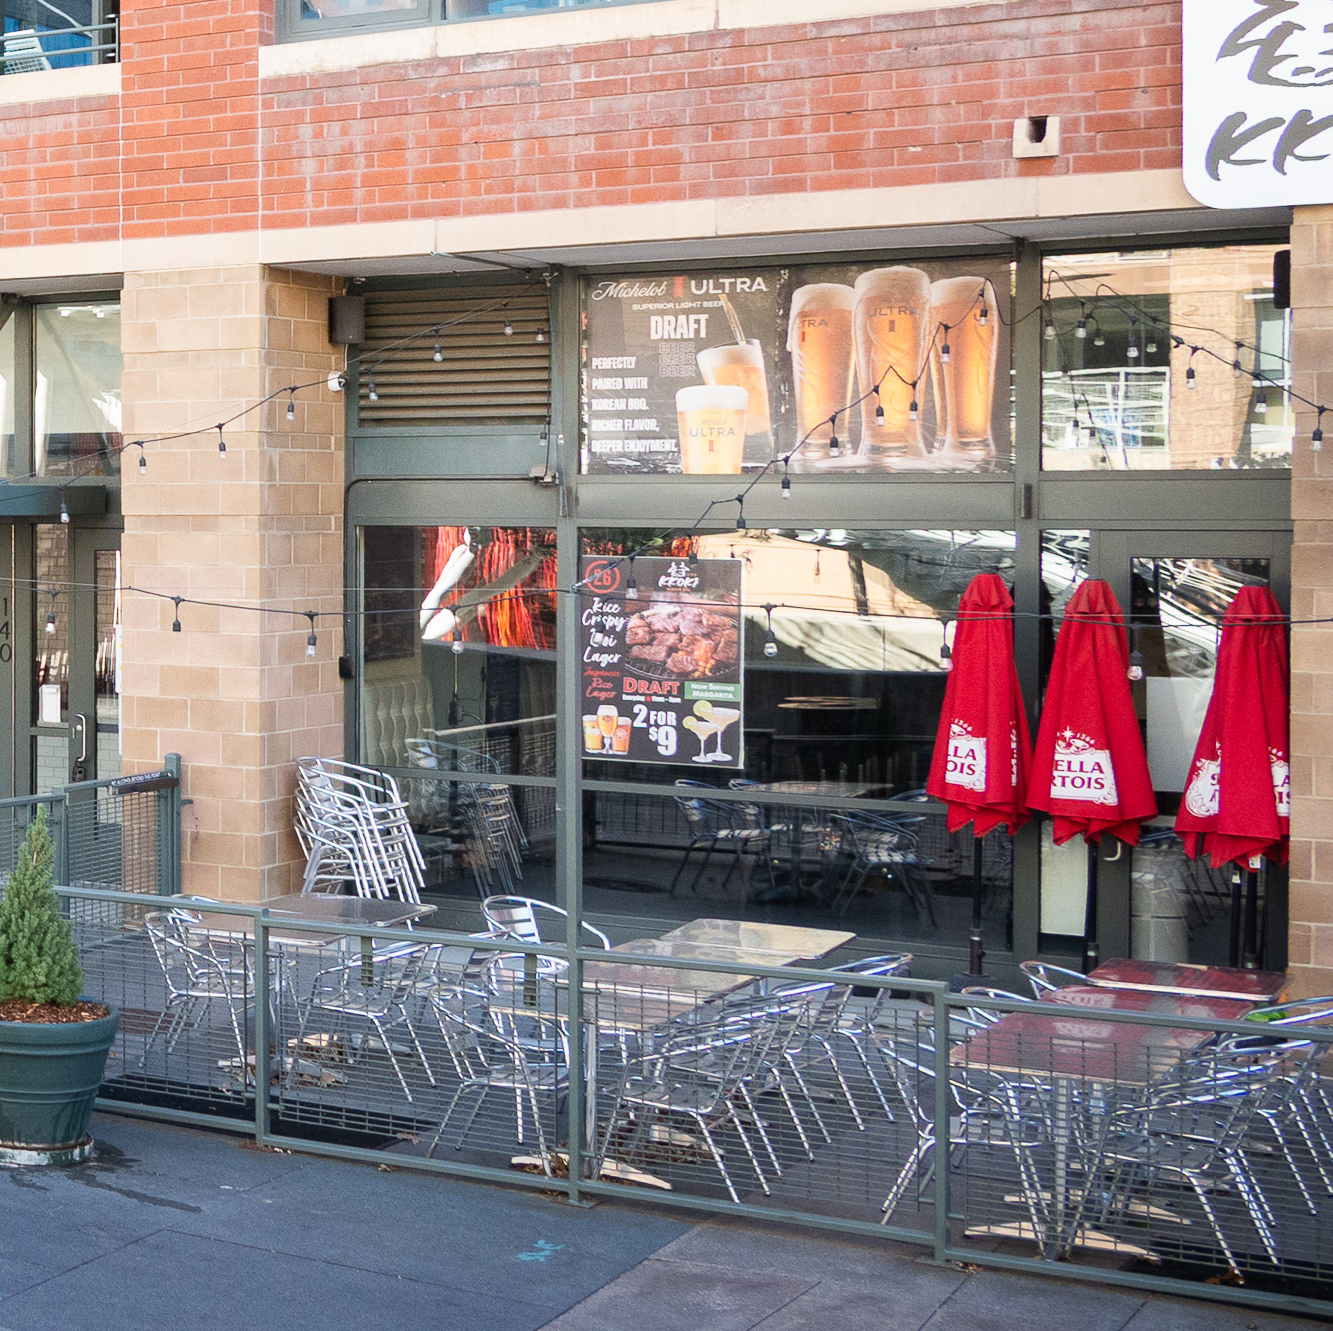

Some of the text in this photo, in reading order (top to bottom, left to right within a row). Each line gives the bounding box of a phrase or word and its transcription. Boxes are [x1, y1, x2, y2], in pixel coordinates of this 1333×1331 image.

[591, 277, 767, 301] Michelob ULTRA
[632, 302, 674, 311] SUPERIOR
[676, 301, 701, 309] LIGHT
[650, 314, 709, 340] DRAFT
[659, 342, 695, 354] BEER
[591, 356, 636, 370] PERFECTLY
[659, 353, 695, 365] BEER
[659, 365, 696, 377] BEER
[591, 377, 648, 390] PAIRED WITH
[591, 398, 627, 411] KOREAN
[591, 419, 623, 432] RICHER
[689, 427, 736, 437] ULTRA
[591, 439, 623, 452] DEEPER
[594, 571, 611, 585] 26
[593, 597, 621, 613] Rice
[583, 646, 622, 667] Lager
[622, 677, 680, 694] DRAFT
[633, 704, 677, 728] 2 FOR
